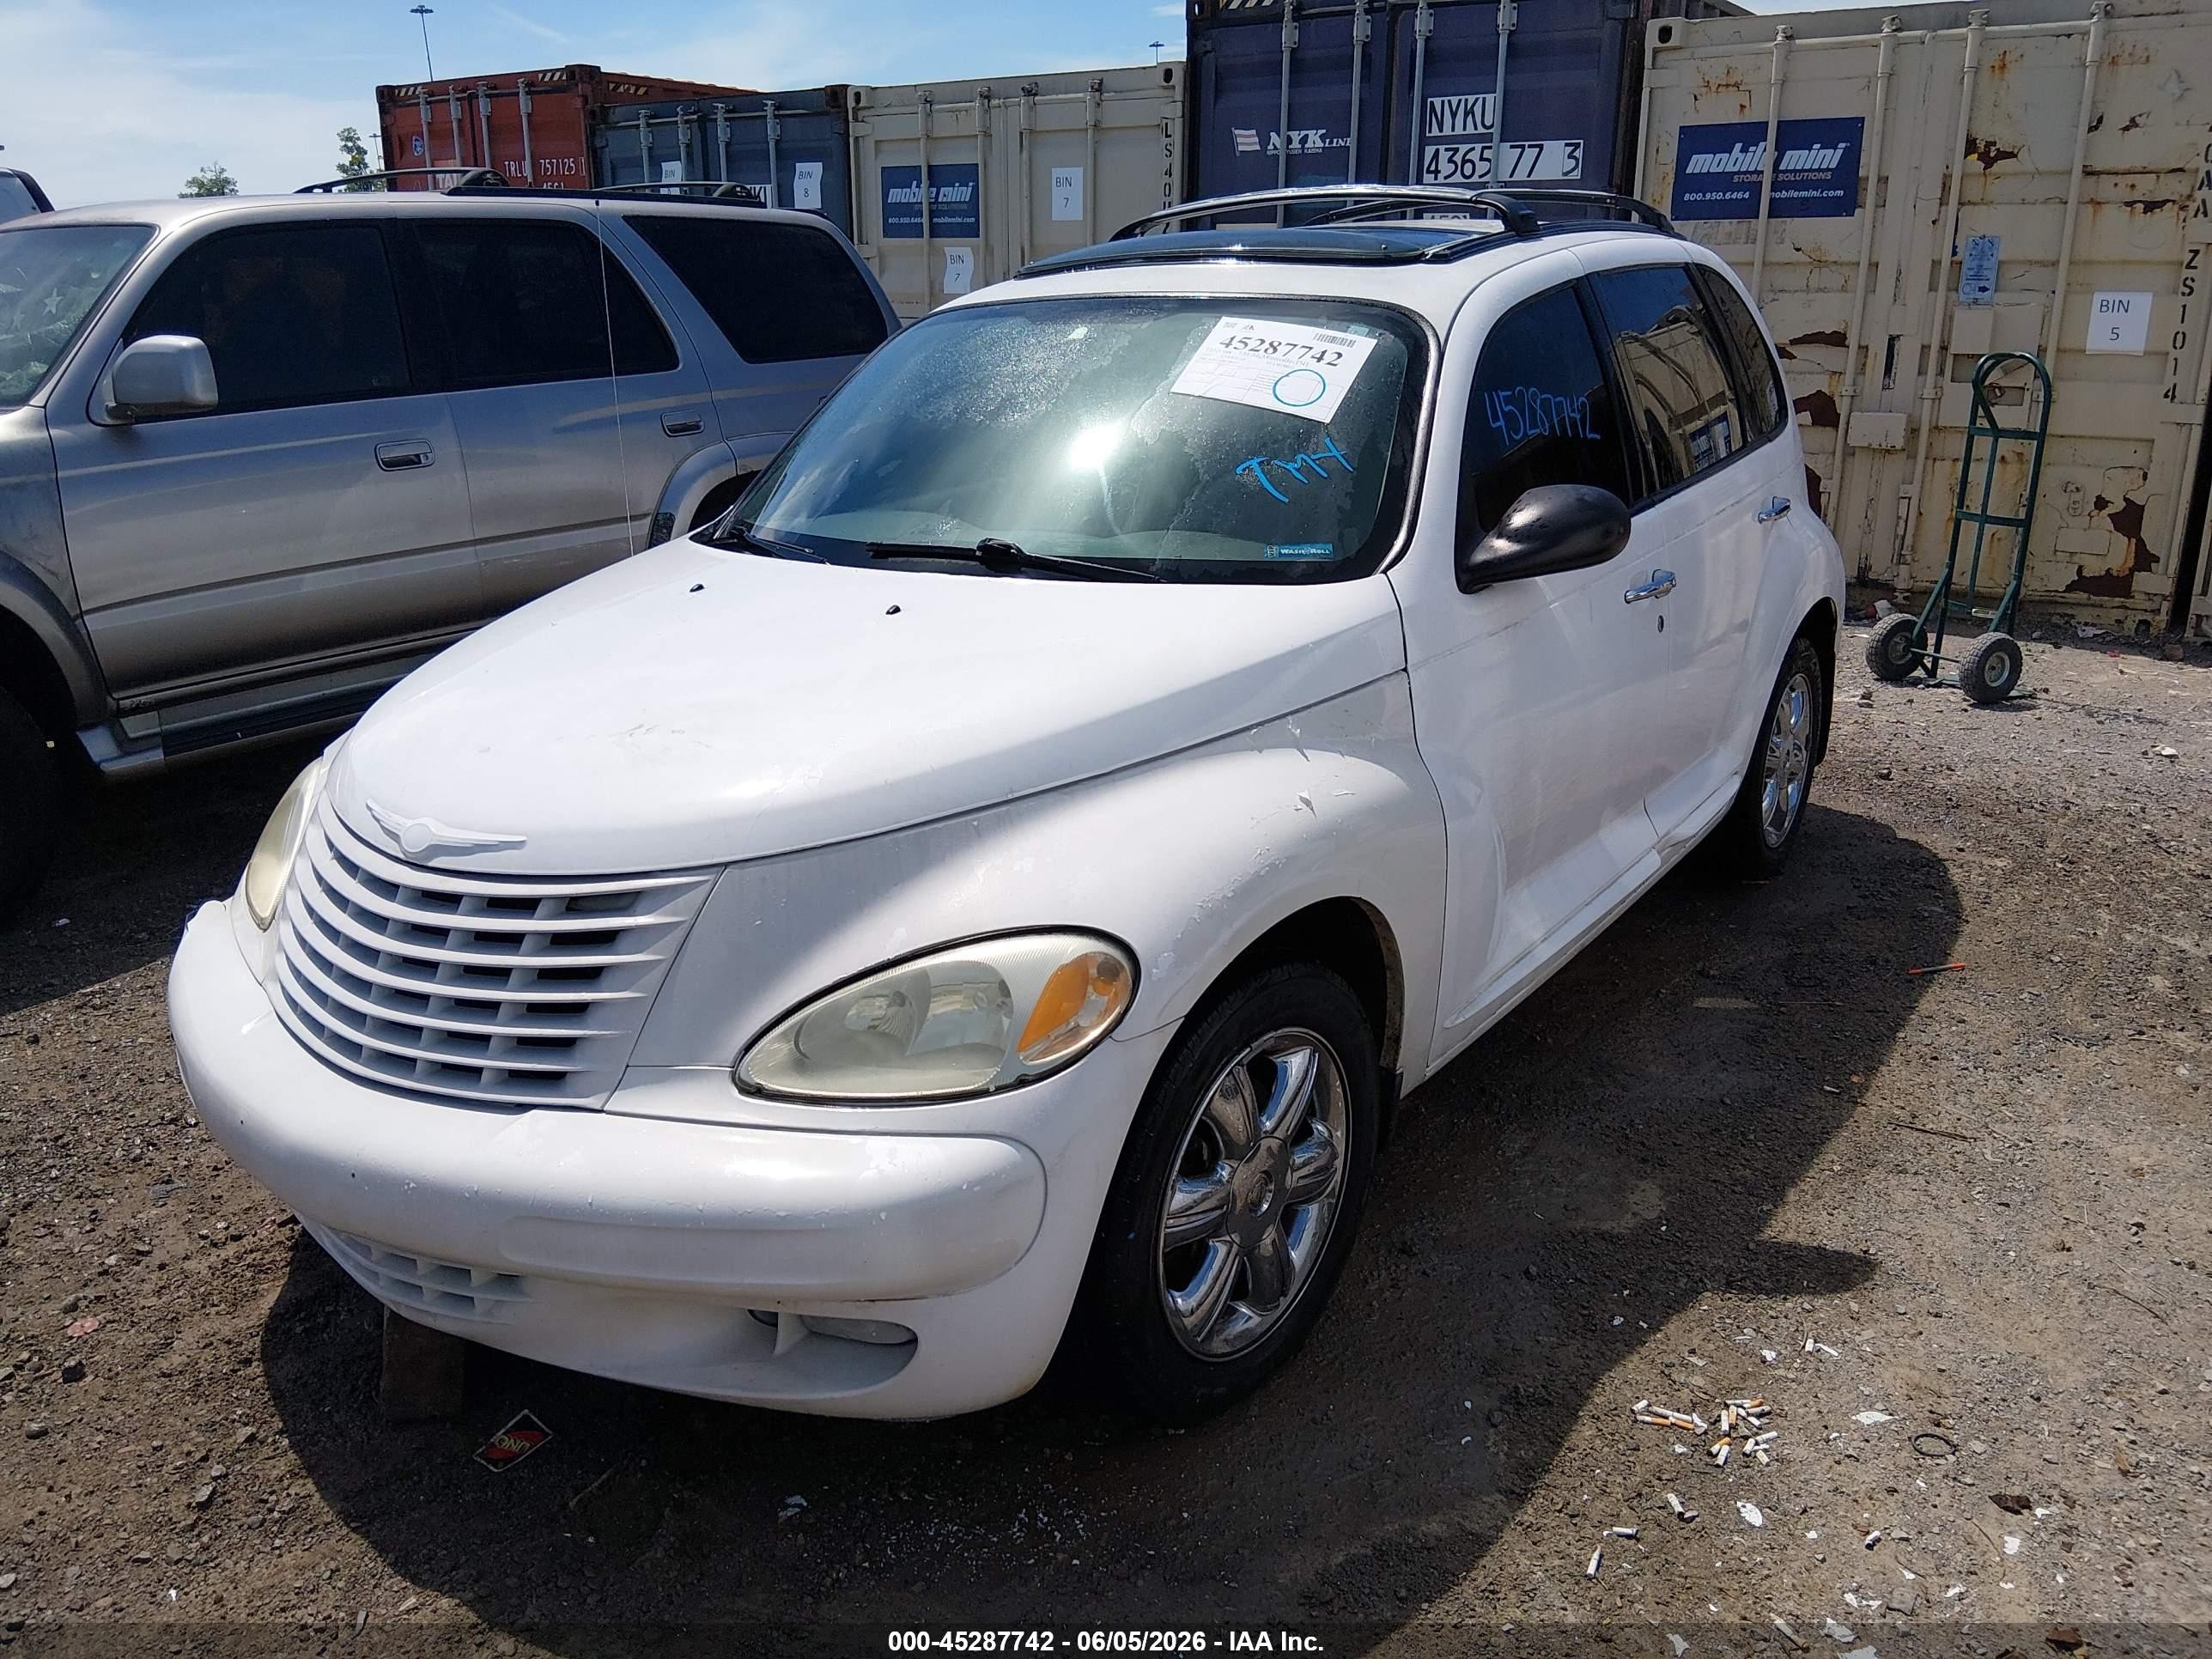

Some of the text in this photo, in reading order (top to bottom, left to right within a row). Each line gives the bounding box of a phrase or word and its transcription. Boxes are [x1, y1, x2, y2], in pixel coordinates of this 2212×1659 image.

[1428, 96, 1497, 134] NYKU
[1267, 129, 1326, 149] NYK
[1561, 142, 1581, 177] 3
[1686, 142, 1846, 174] mobil mini
[504, 160, 528, 178] TRLU
[539, 157, 575, 177] 757125
[665, 169, 676, 179] BIN
[799, 171, 813, 180] BIN
[1055, 177, 1073, 187] BIN
[1732, 172, 1832, 183] STORAE SOLUTIONS
[804, 187, 809, 198] 8
[938, 181, 974, 203] mini
[1683, 191, 1750, 201] 800.950.6464
[1063, 197, 1069, 208] 7
[950, 254, 964, 264] BIN
[954, 273, 960, 282] 7
[2099, 299, 2130, 313] BIN
[2109, 326, 2119, 341] 5
[1219, 334, 1343, 368] 45287742
[1485, 386, 1601, 447] 45287742
